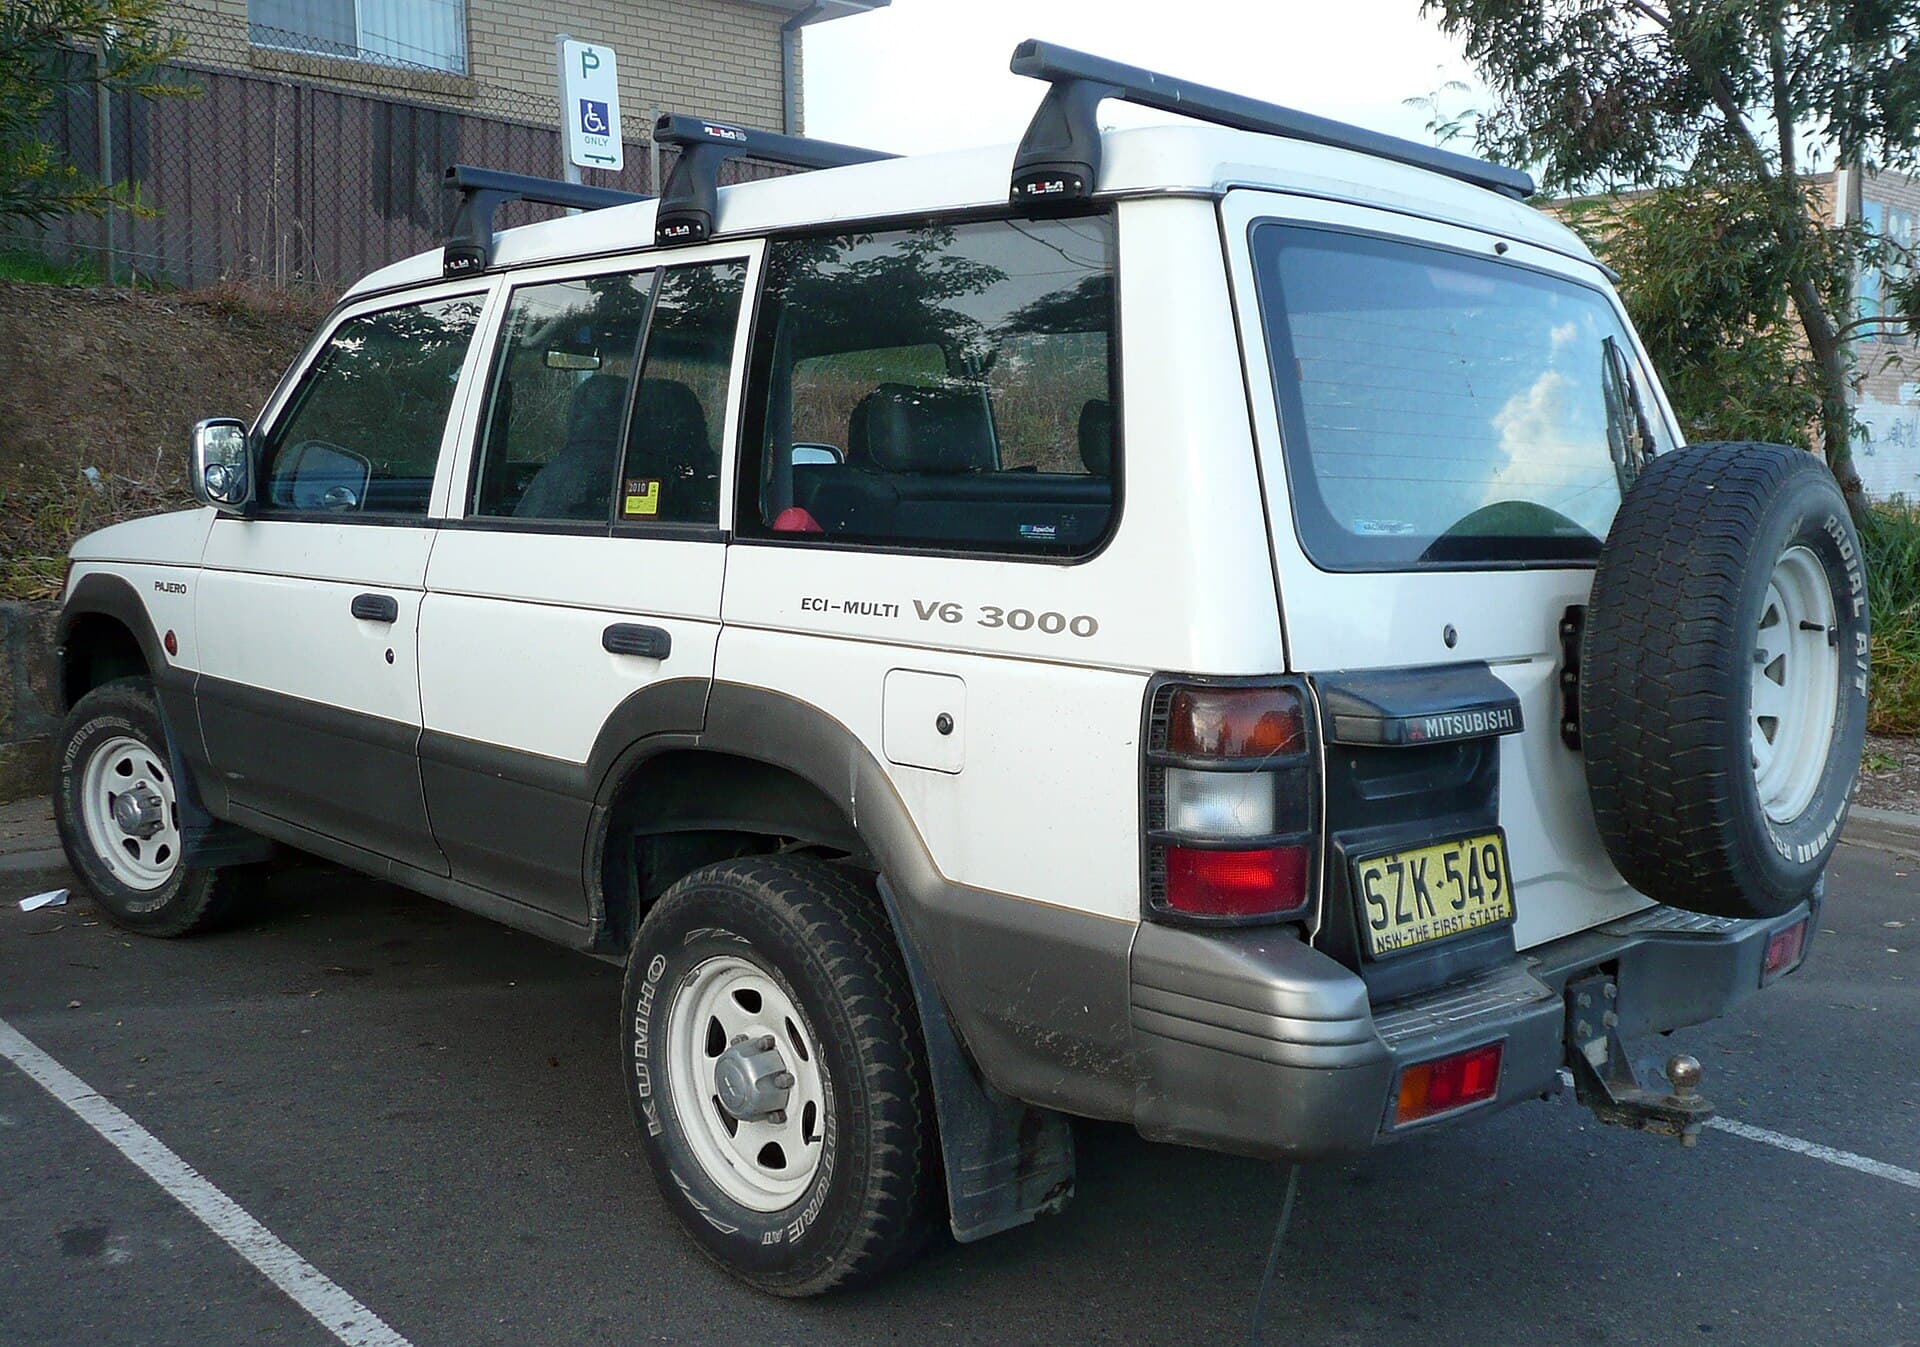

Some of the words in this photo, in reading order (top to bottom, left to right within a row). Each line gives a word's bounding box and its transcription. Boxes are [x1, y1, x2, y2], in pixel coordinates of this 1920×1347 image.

[581, 49, 601, 79] P
[584, 135, 609, 148] ONLY
[628, 482, 647, 493] 2010
[154, 581, 188, 594] PAJERO
[800, 598, 900, 618] ECI-MULTI
[912, 599, 964, 624] V6
[977, 606, 1099, 638] 3000
[1823, 514, 1866, 618] RADIAL
[1855, 632, 1868, 698] A/T
[1426, 708, 1514, 739] MITSUBISHI
[61, 715, 133, 774] VENTURE
[1433, 914, 1465, 937] FIRST
[1469, 904, 1505, 927] STATE
[634, 953, 667, 1137] KUMHO
